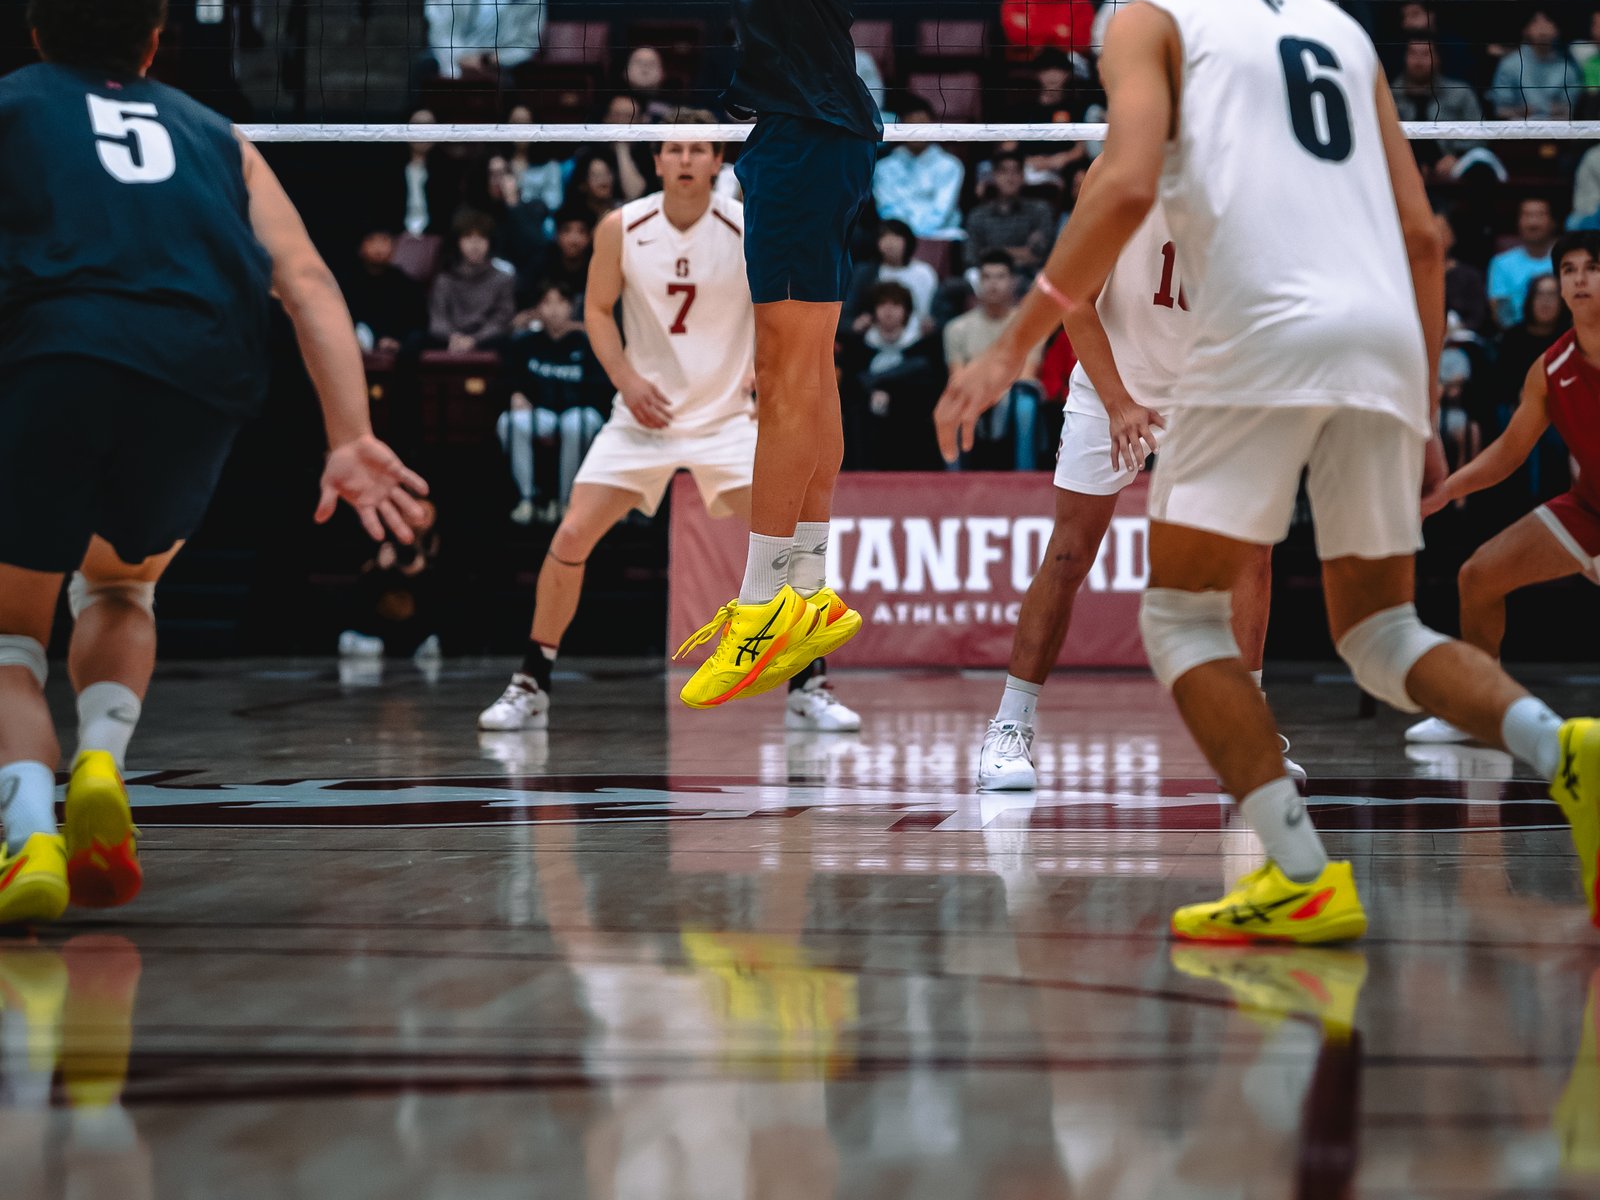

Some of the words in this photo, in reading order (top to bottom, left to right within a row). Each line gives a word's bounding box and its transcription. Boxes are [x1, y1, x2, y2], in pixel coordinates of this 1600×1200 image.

[87, 94, 176, 183] 5
[1278, 35, 1356, 163] 6
[667, 284, 697, 334] 7
[1153, 240, 1190, 312] 1
